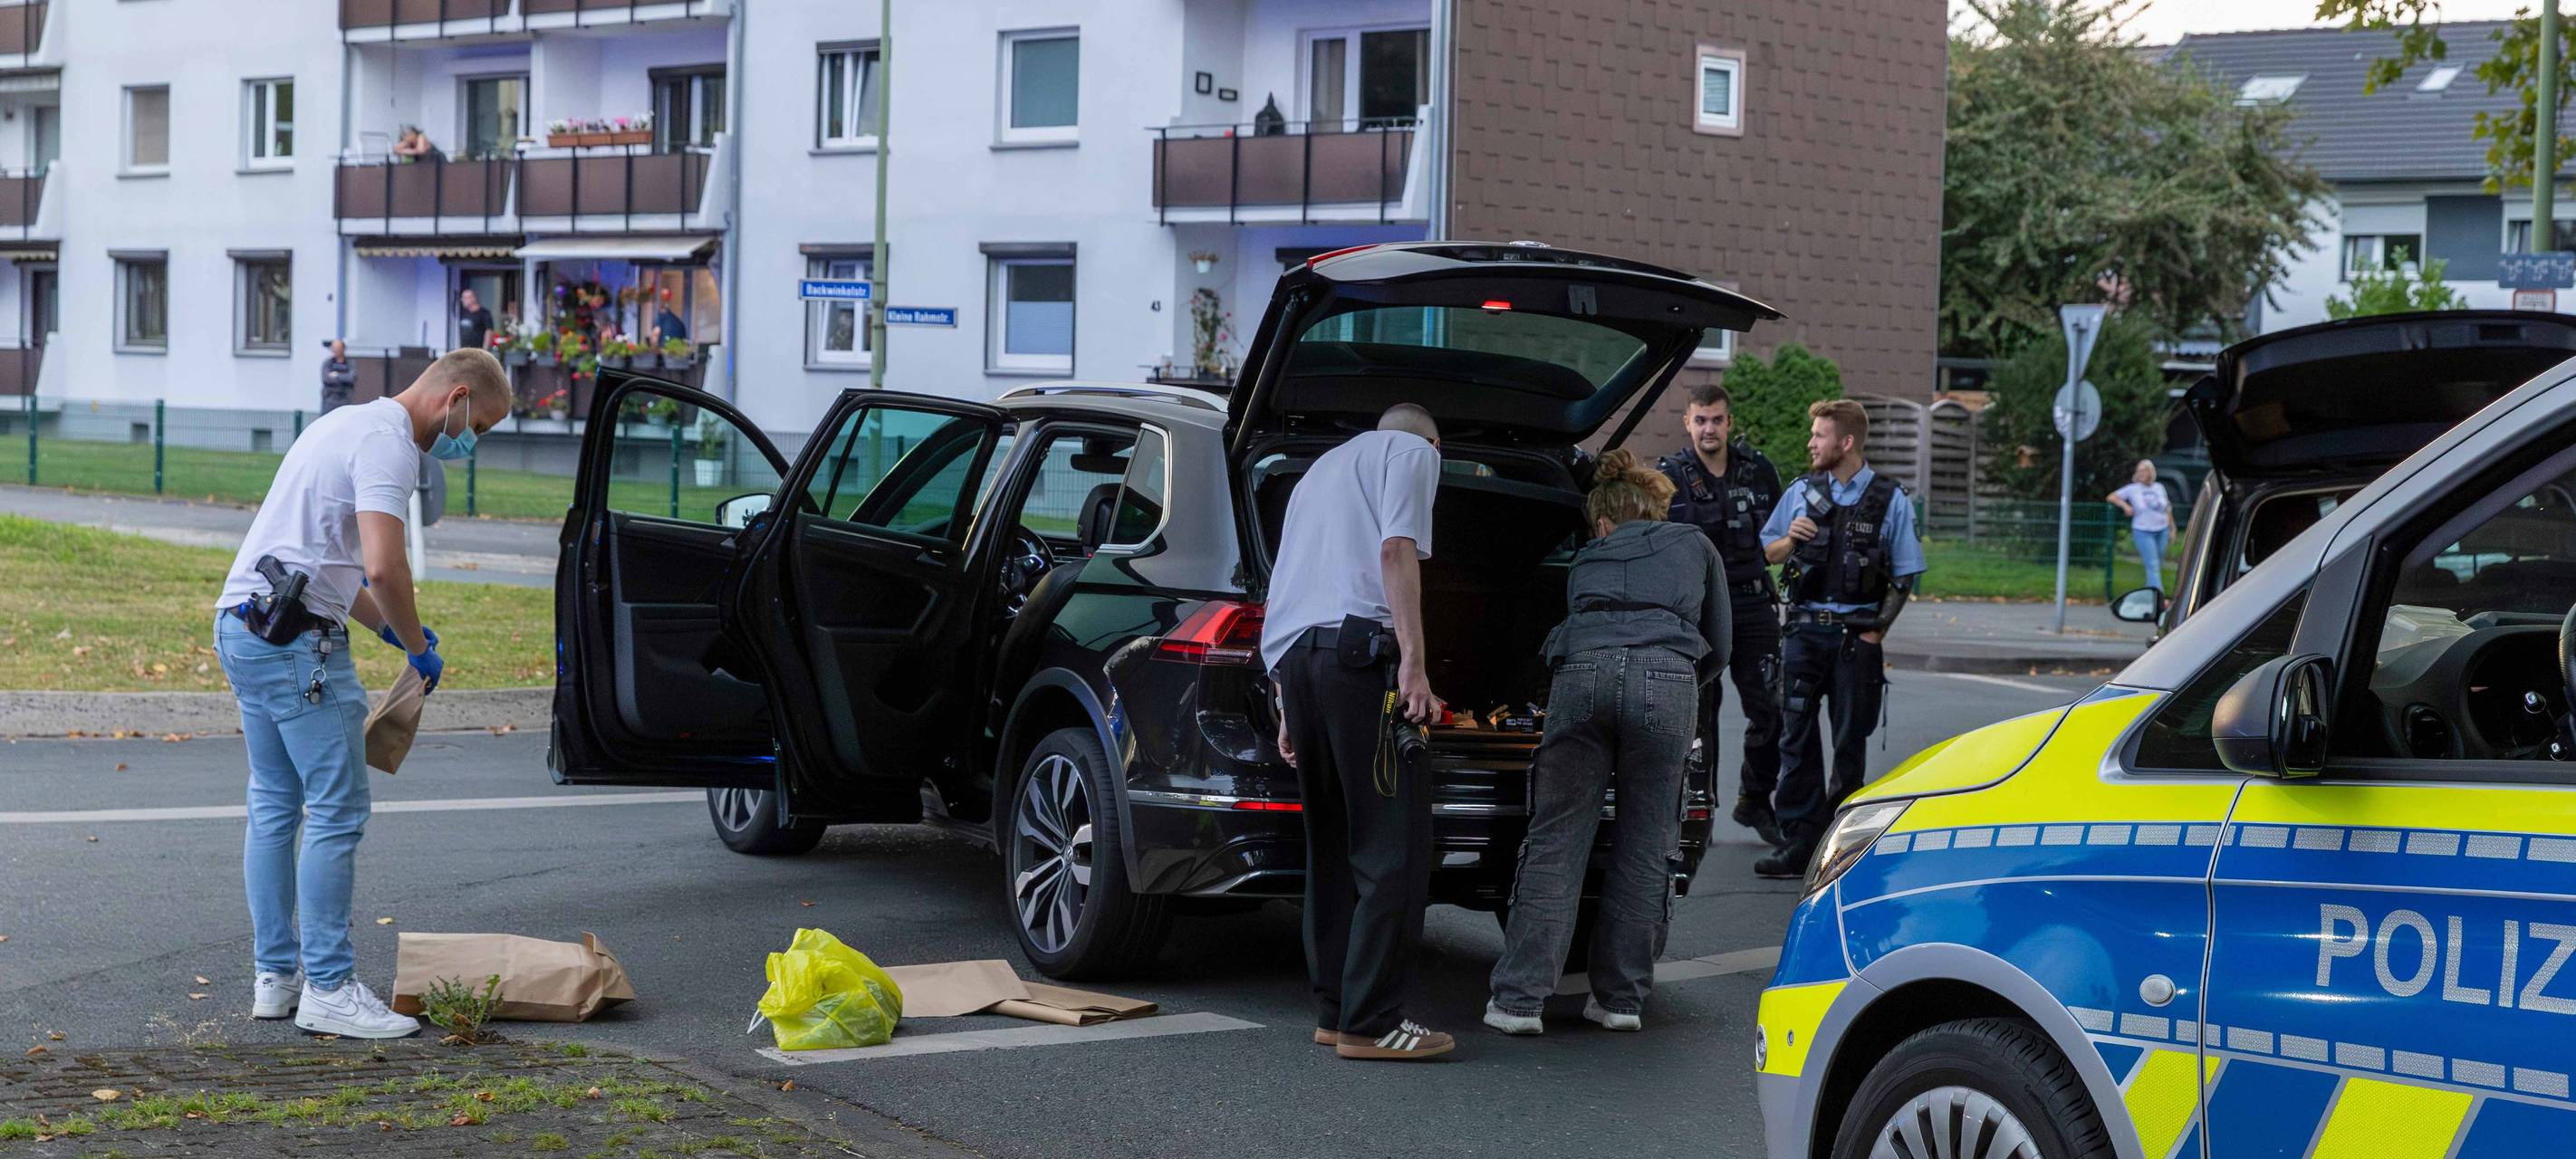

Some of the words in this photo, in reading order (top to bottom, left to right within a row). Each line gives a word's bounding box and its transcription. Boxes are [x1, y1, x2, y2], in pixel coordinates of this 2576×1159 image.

[888, 310, 913, 321] Kleine
[1385, 691, 1396, 714] Nikon
[2316, 903, 2576, 1015] POLIZ
